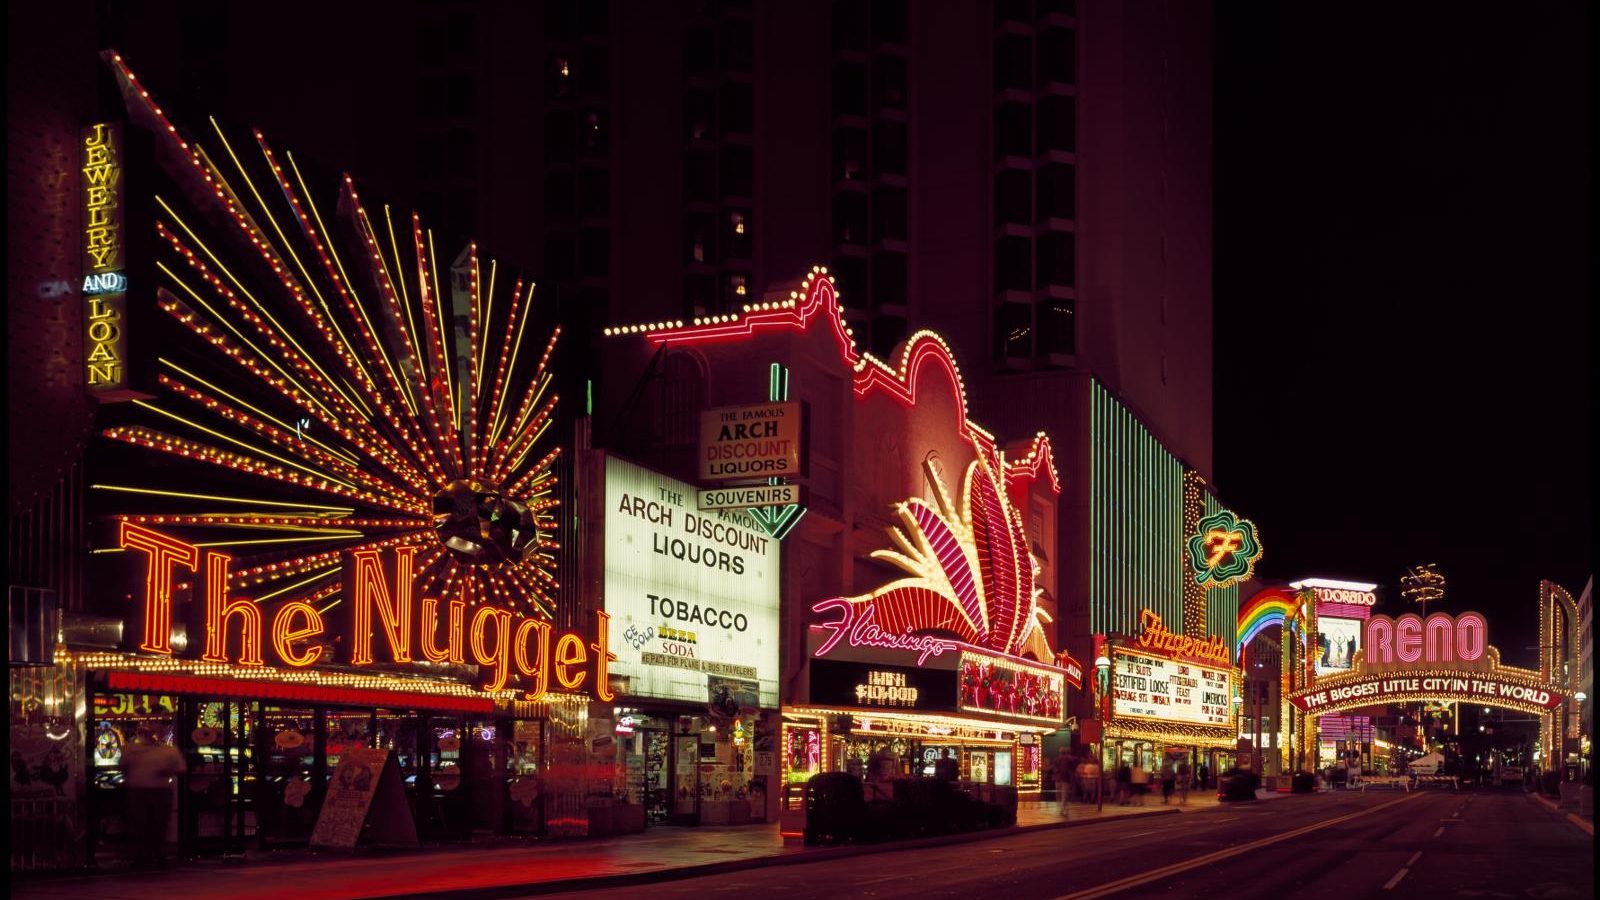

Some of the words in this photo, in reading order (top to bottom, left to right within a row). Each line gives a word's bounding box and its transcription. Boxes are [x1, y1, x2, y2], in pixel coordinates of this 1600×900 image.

[82, 123, 112, 268] JEWELRY
[82, 272, 119, 291] AND
[87, 299, 115, 385] LOAN
[720, 412, 737, 422] THE
[742, 408, 785, 420] FAMOUS
[718, 421, 778, 441] ARCH
[707, 440, 790, 461] DISCOUNT
[710, 459, 787, 475] LIQUORS
[659, 487, 684, 507] THE
[705, 488, 792, 506] SOUVENIRS
[619, 493, 672, 527] ARCH
[685, 513, 769, 555] DISCOUNT
[653, 532, 745, 575] LIQUORS
[120, 520, 324, 667] The
[352, 545, 618, 702] Nugget
[646, 594, 748, 633] TOBACCO
[623, 624, 638, 643] ICE
[632, 626, 654, 651] COLD
[658, 626, 697, 645] BEER
[810, 598, 958, 666] Flamingo
[1139, 608, 1230, 663] Fitzgeralds
[1367, 615, 1484, 663] RENO
[662, 642, 695, 658] SODA
[650, 654, 666, 665] PACK
[667, 656, 679, 667] FOR
[680, 658, 700, 670] PLANE
[708, 663, 720, 673] BUS
[722, 664, 754, 676] TRAVELERS
[1136, 665, 1152, 676] SLOTS
[1115, 674, 1147, 691] CERTIFIED
[1150, 679, 1170, 695] LOOSE
[1176, 687, 1191, 698] FEAST
[1304, 691, 1327, 708] THE
[1330, 683, 1380, 701] BIGGEST
[1383, 679, 1420, 693] LITTLE
[1422, 678, 1451, 691] CITY
[1453, 678, 1469, 692] IN
[1471, 680, 1495, 695] THE
[1499, 683, 1550, 705] WORLD
[1202, 690, 1228, 706] LIMERICKS
